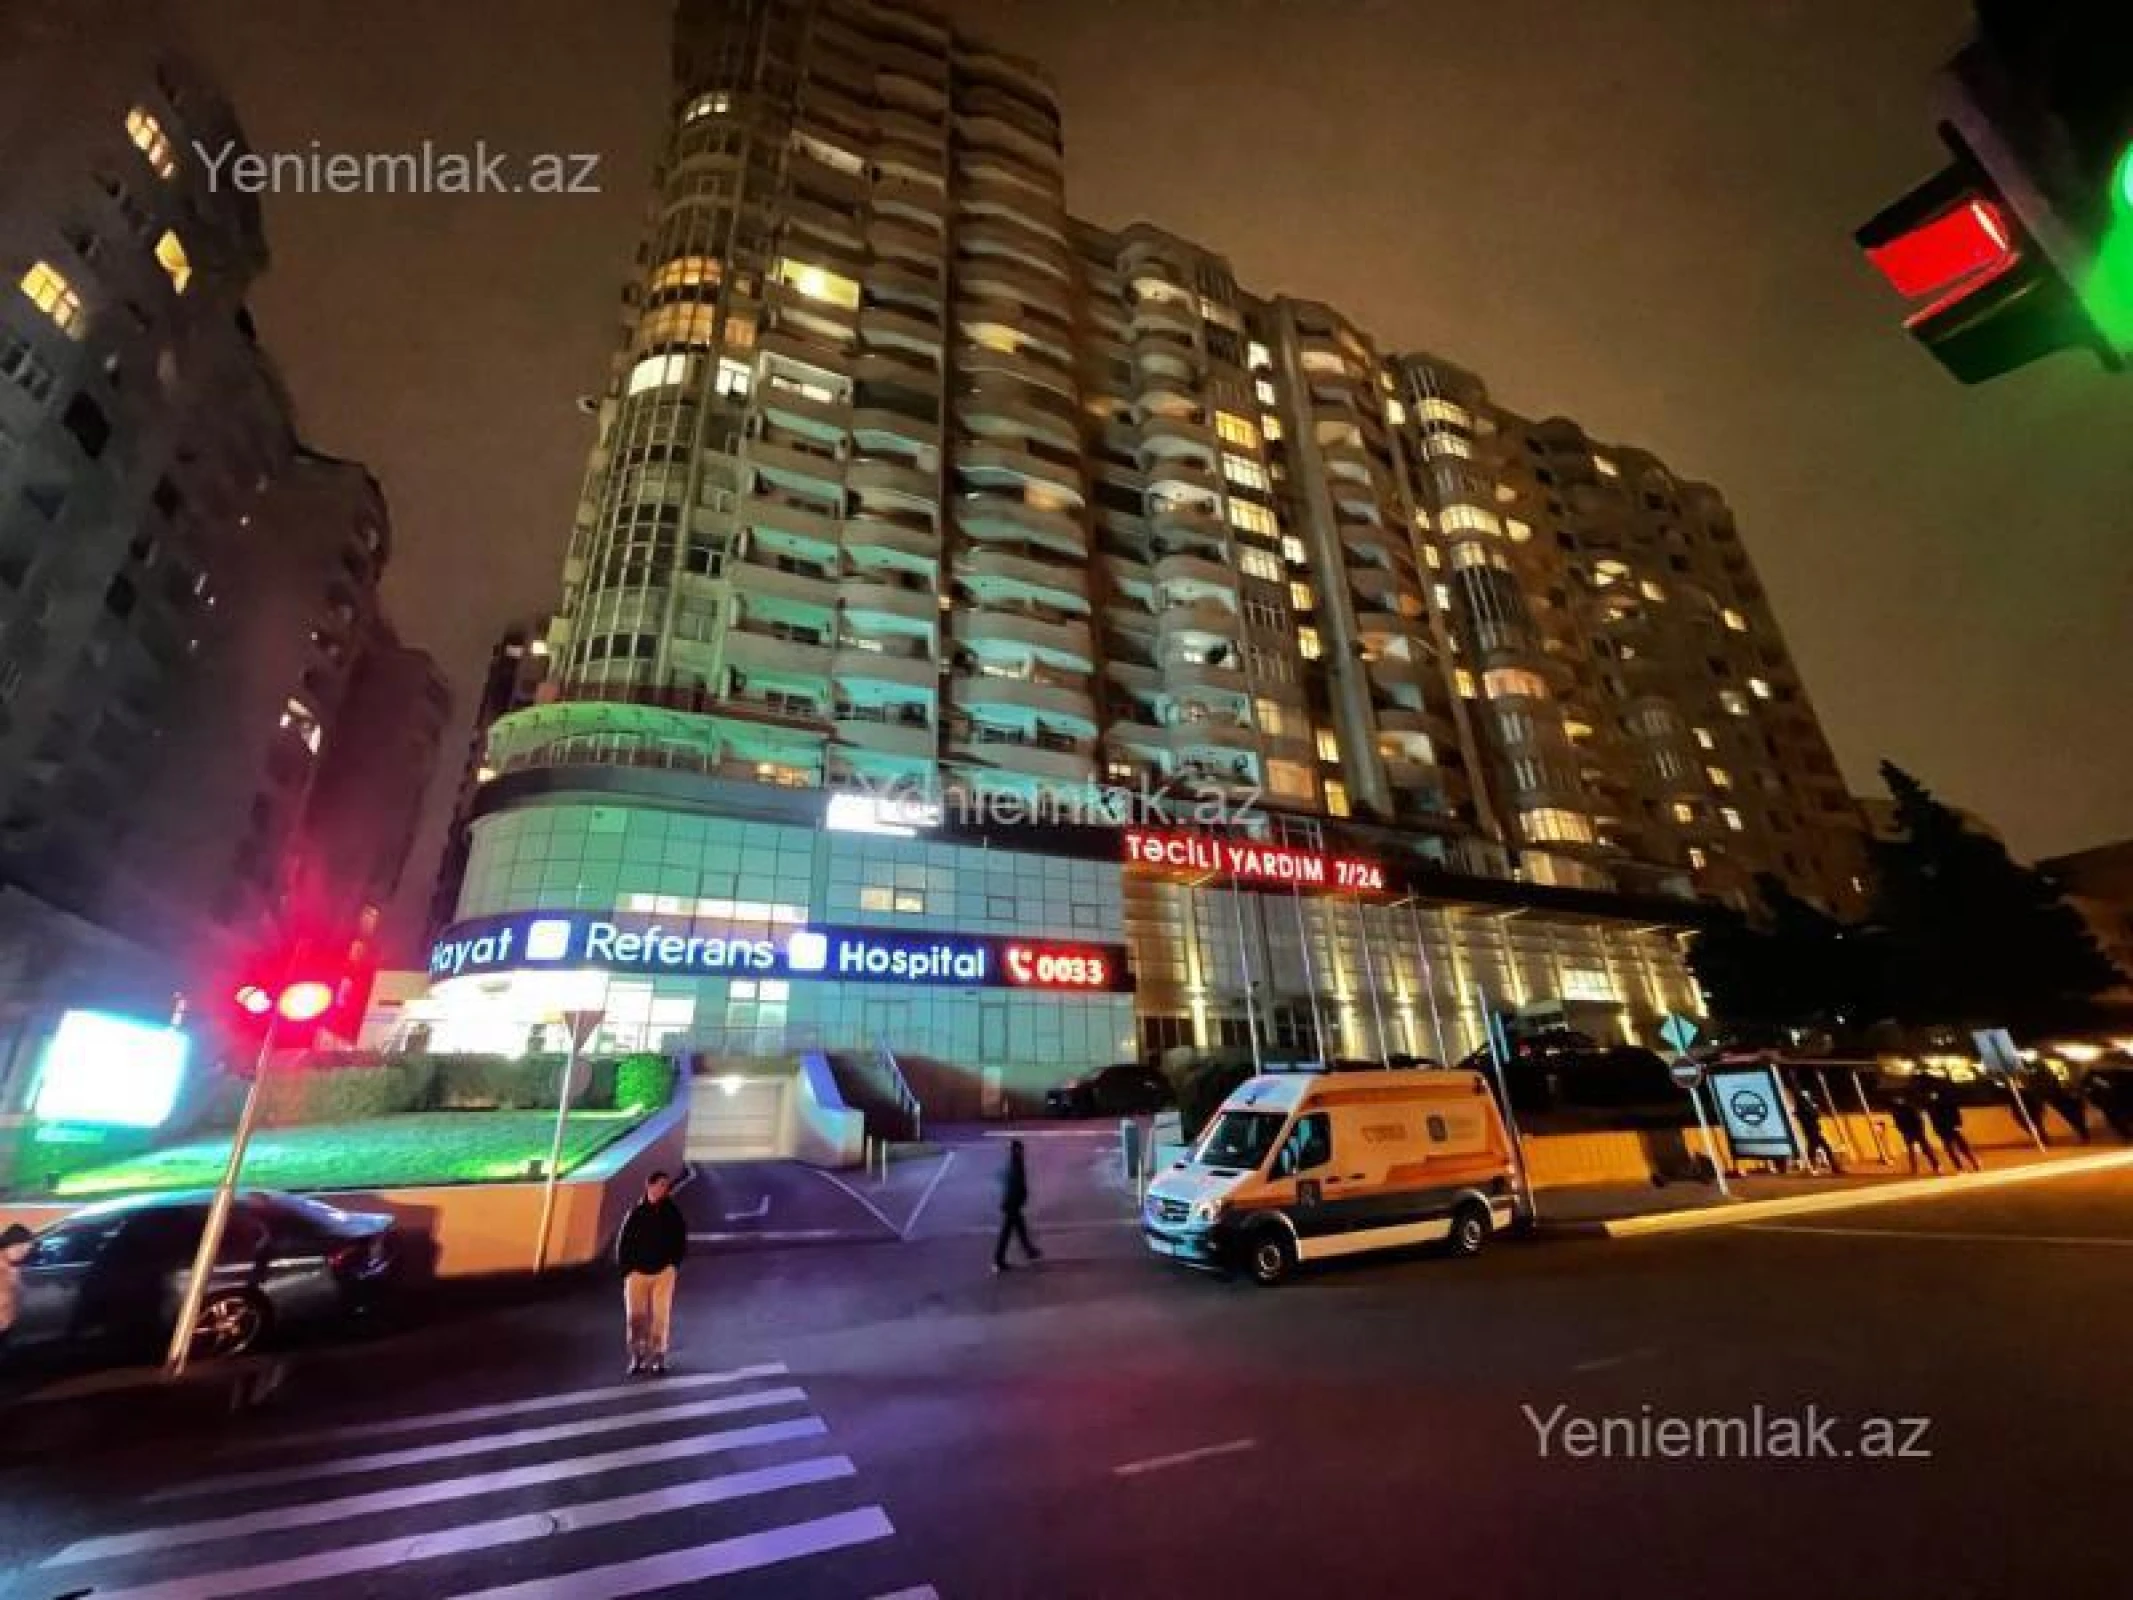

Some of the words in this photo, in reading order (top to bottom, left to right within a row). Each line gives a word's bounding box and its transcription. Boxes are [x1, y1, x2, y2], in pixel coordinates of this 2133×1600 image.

[1228, 847, 1324, 881] YARDIM
[1334, 860, 1383, 889] 7/24
[586, 921, 775, 969] Referans
[839, 940, 985, 980] Hospital
[1036, 955, 1105, 985] 0033
